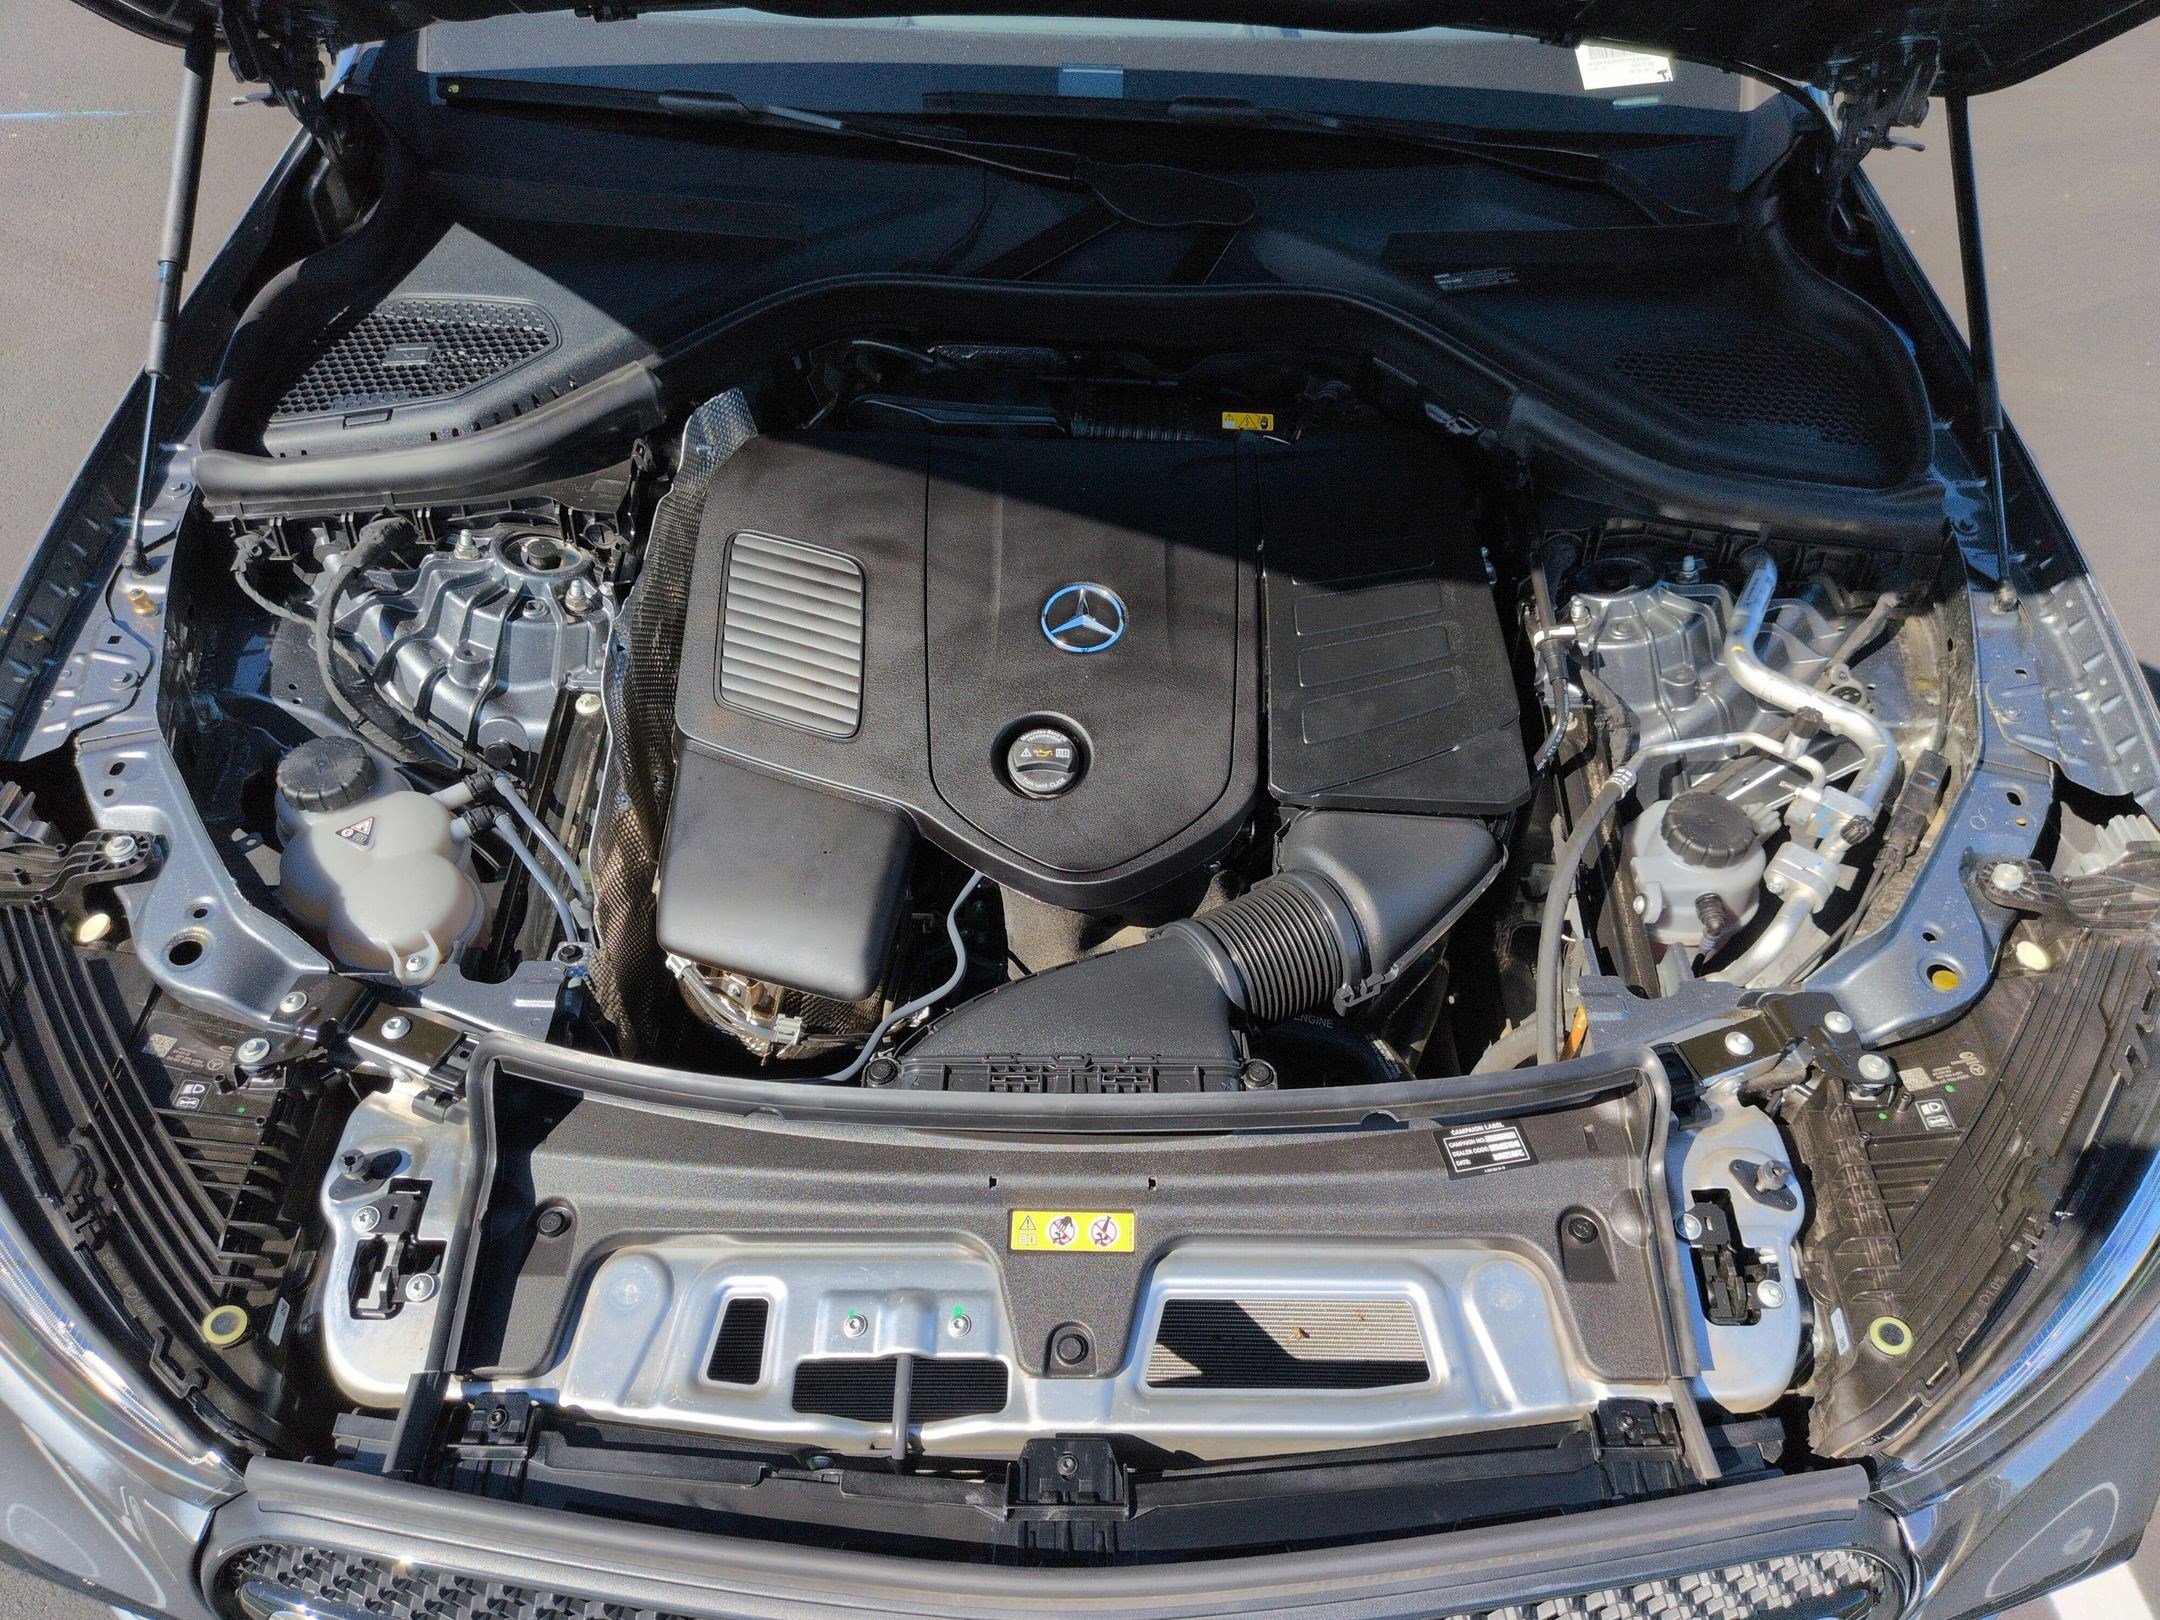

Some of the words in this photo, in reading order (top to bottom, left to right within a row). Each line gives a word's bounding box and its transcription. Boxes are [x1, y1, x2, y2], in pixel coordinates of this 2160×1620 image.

[1450, 1125, 1484, 1136] CAMPAIGN
[1484, 1122, 1505, 1131] LABEL
[1448, 1138, 1476, 1149] CAMPAIGN
[1451, 1148, 1474, 1157] DEALER
